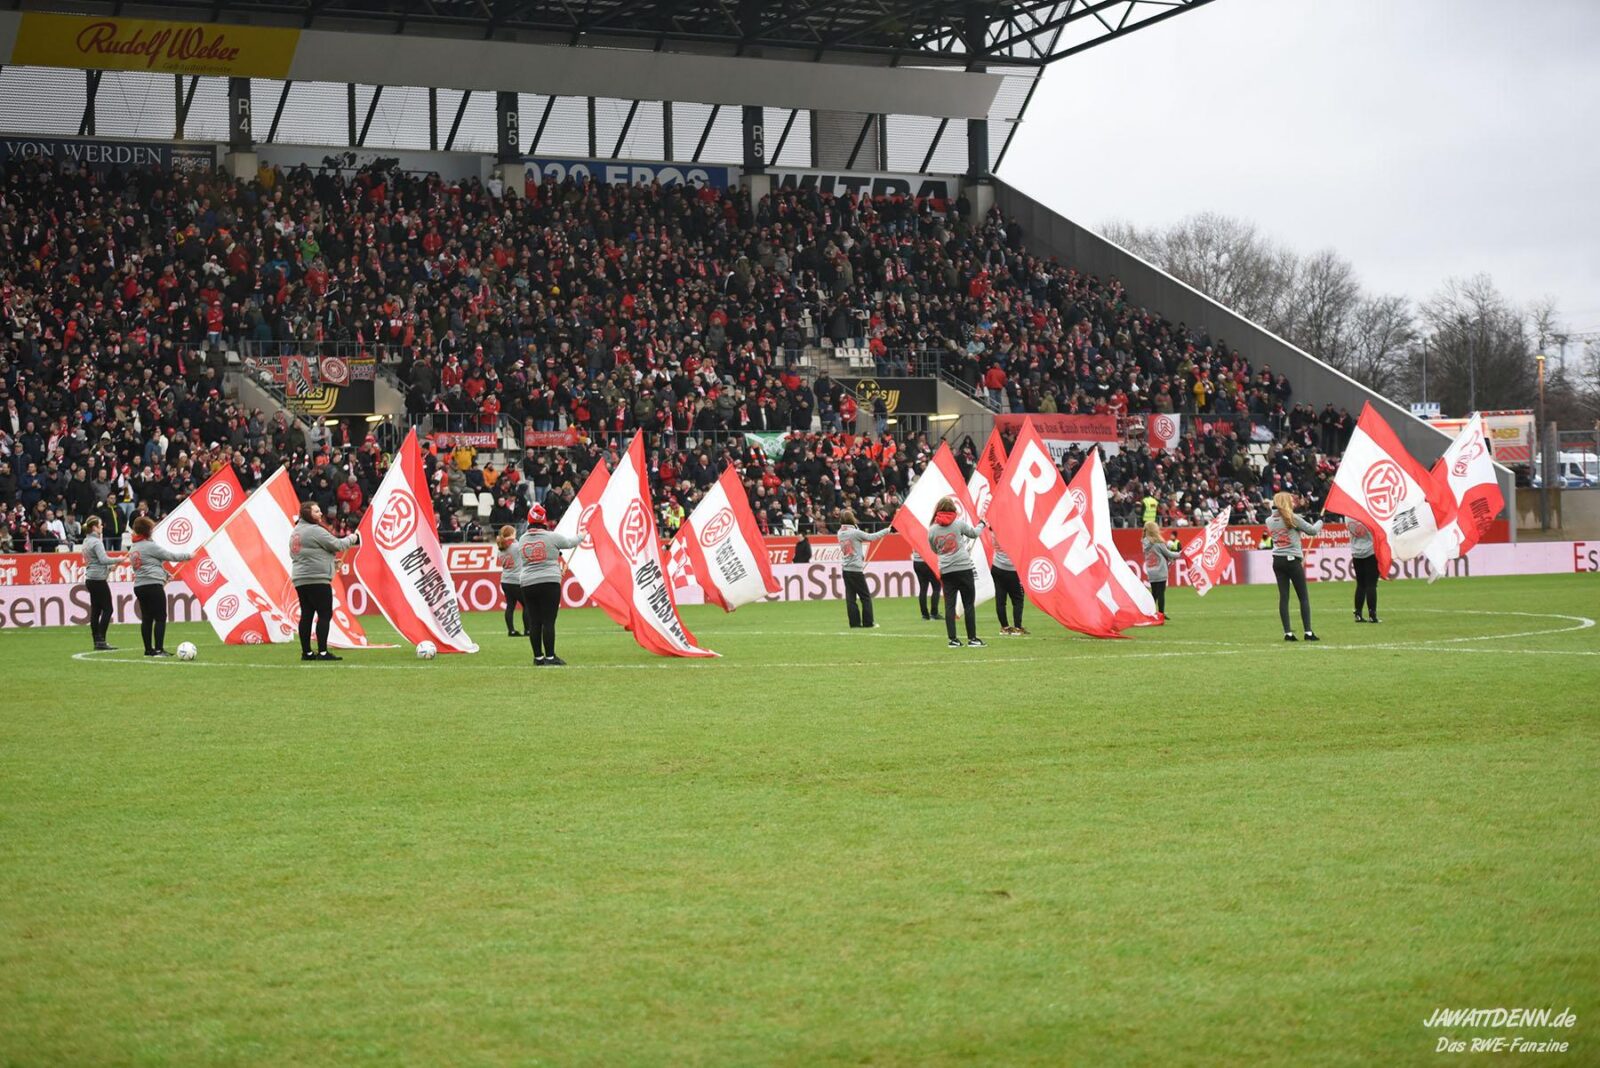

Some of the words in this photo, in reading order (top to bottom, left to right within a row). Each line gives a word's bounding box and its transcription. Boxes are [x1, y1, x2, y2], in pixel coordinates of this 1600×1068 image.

[77, 22, 171, 68] Rudolf
[167, 27, 240, 60] Weber
[238, 99, 249, 115] R
[239, 118, 249, 133] 4
[507, 112, 518, 127] R
[508, 131, 518, 145] 5
[753, 125, 763, 140] R
[6, 141, 55, 158] VON
[63, 143, 163, 165] WERDEN
[754, 142, 763, 157] 5
[400, 545, 451, 608] ROT-WEISS
[433, 597, 463, 639] ESSEN
